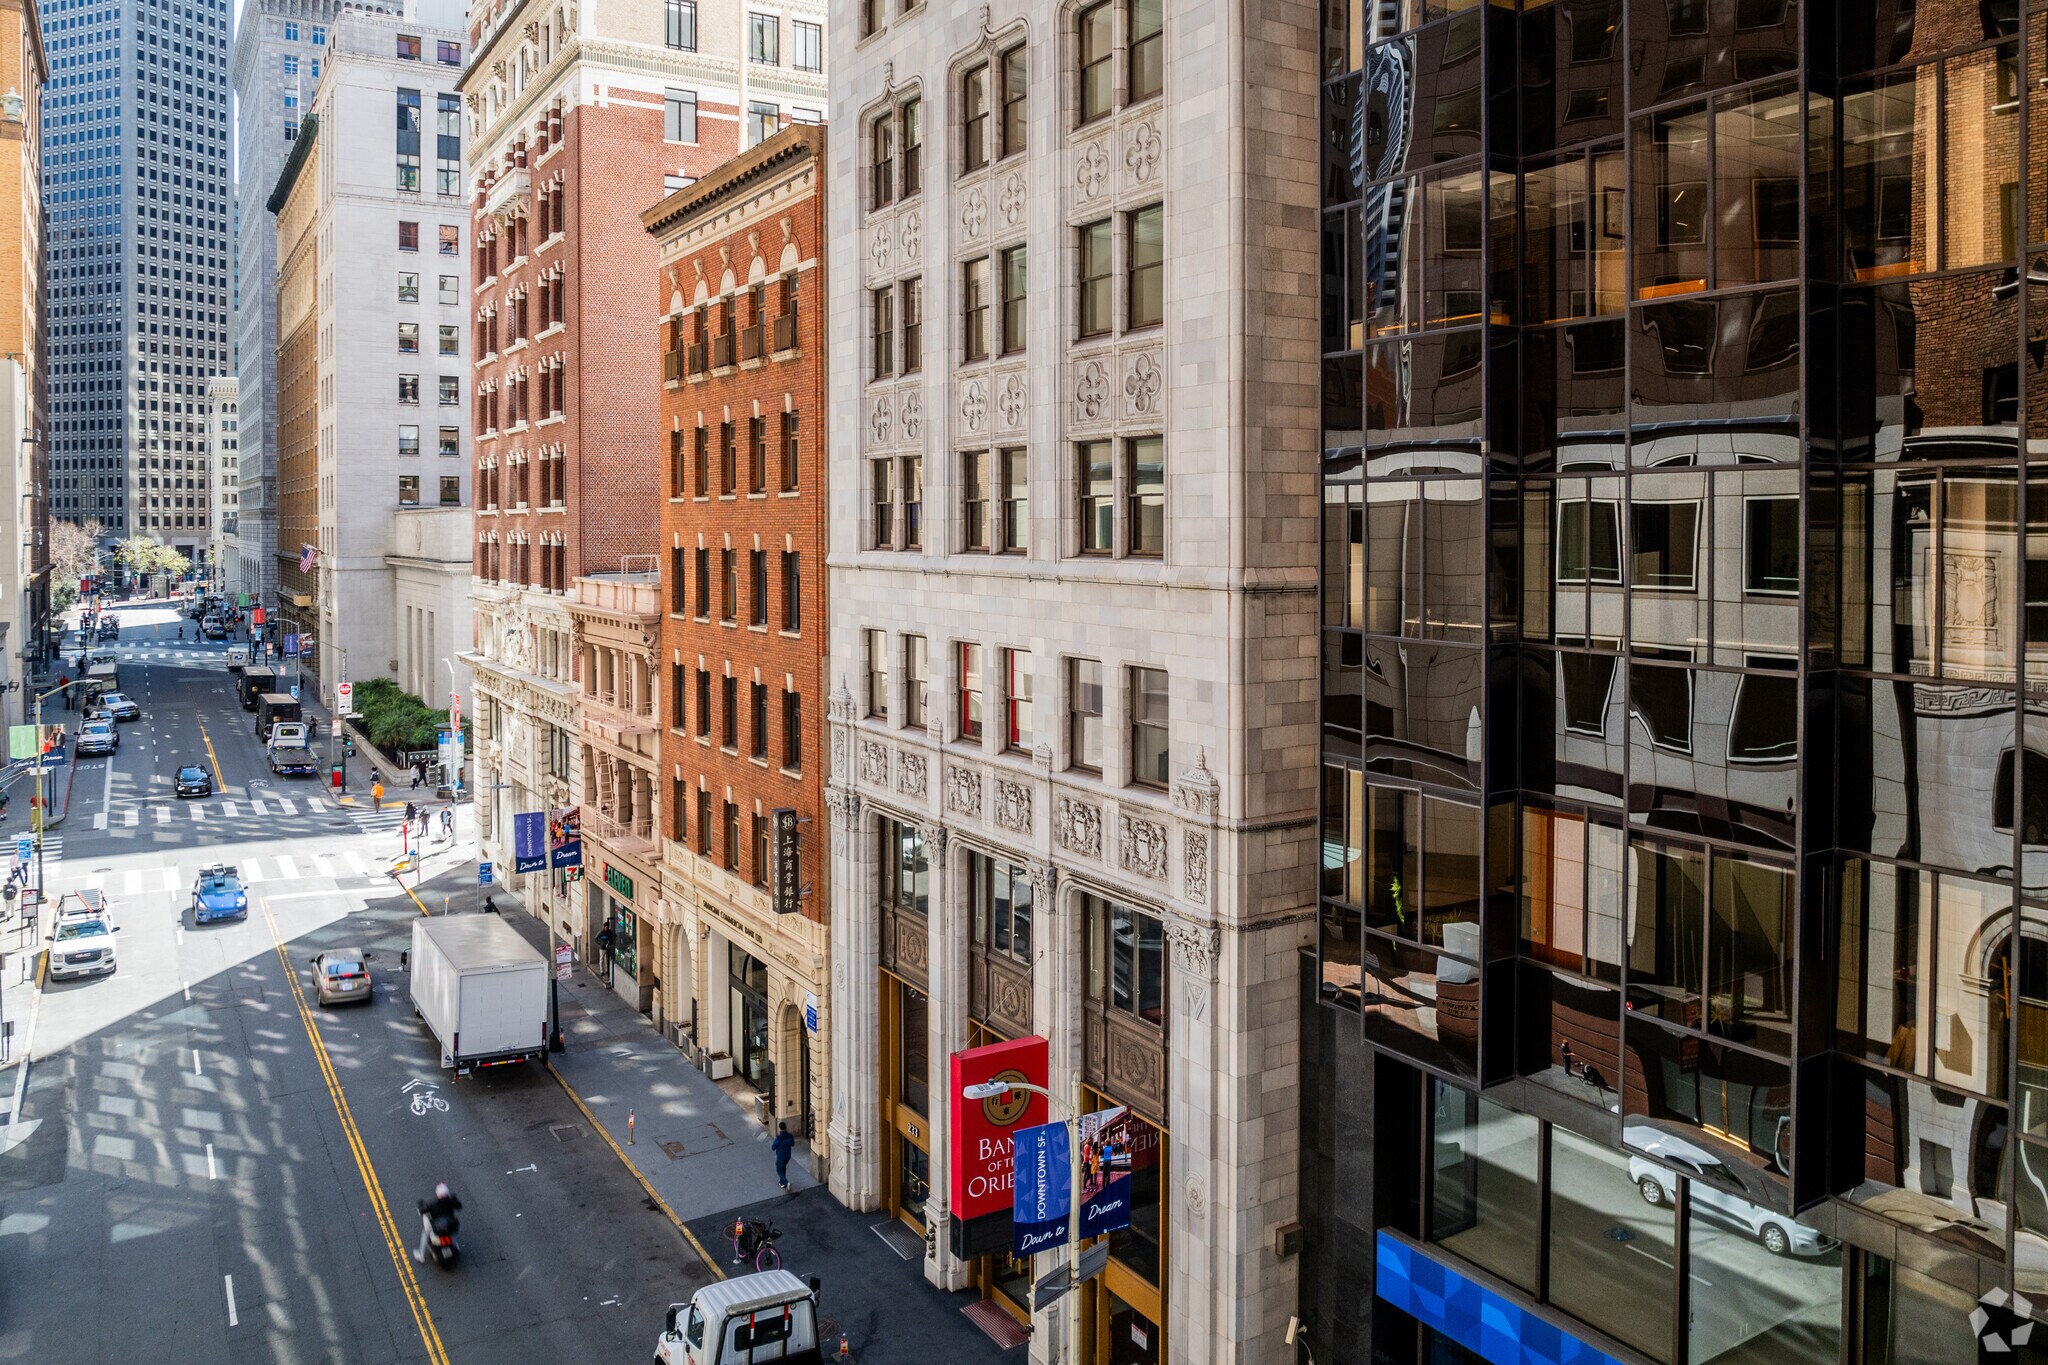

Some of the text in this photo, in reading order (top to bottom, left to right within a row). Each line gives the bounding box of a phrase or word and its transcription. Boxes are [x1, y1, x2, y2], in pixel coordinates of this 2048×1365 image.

[556, 851, 578, 860] Dream
[520, 862, 537, 871] Down
[988, 1160, 1002, 1172] OF
[968, 1172, 1014, 1198] ORIE
[1037, 1136, 1047, 1219] DOWNTOWN SF
[1088, 1199, 1123, 1220] Dream
[1021, 1226, 1065, 1250] Down to
